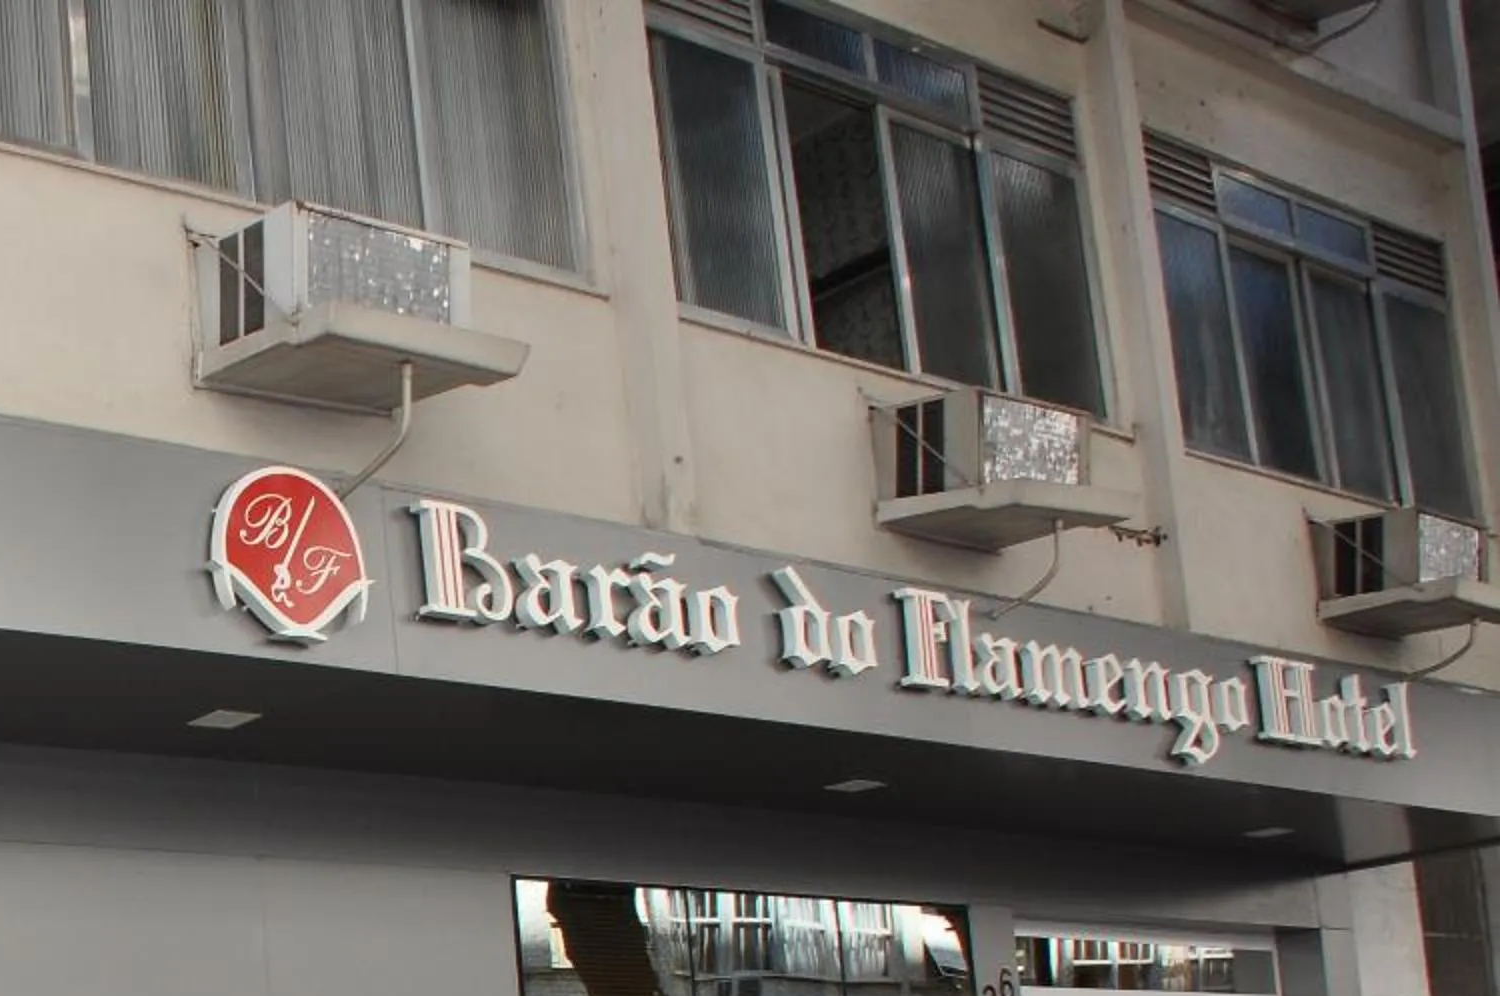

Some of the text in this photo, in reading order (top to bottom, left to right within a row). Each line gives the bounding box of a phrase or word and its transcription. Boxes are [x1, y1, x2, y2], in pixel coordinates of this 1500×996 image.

[409, 499, 1418, 764] Barão do Flamengo Hotel
